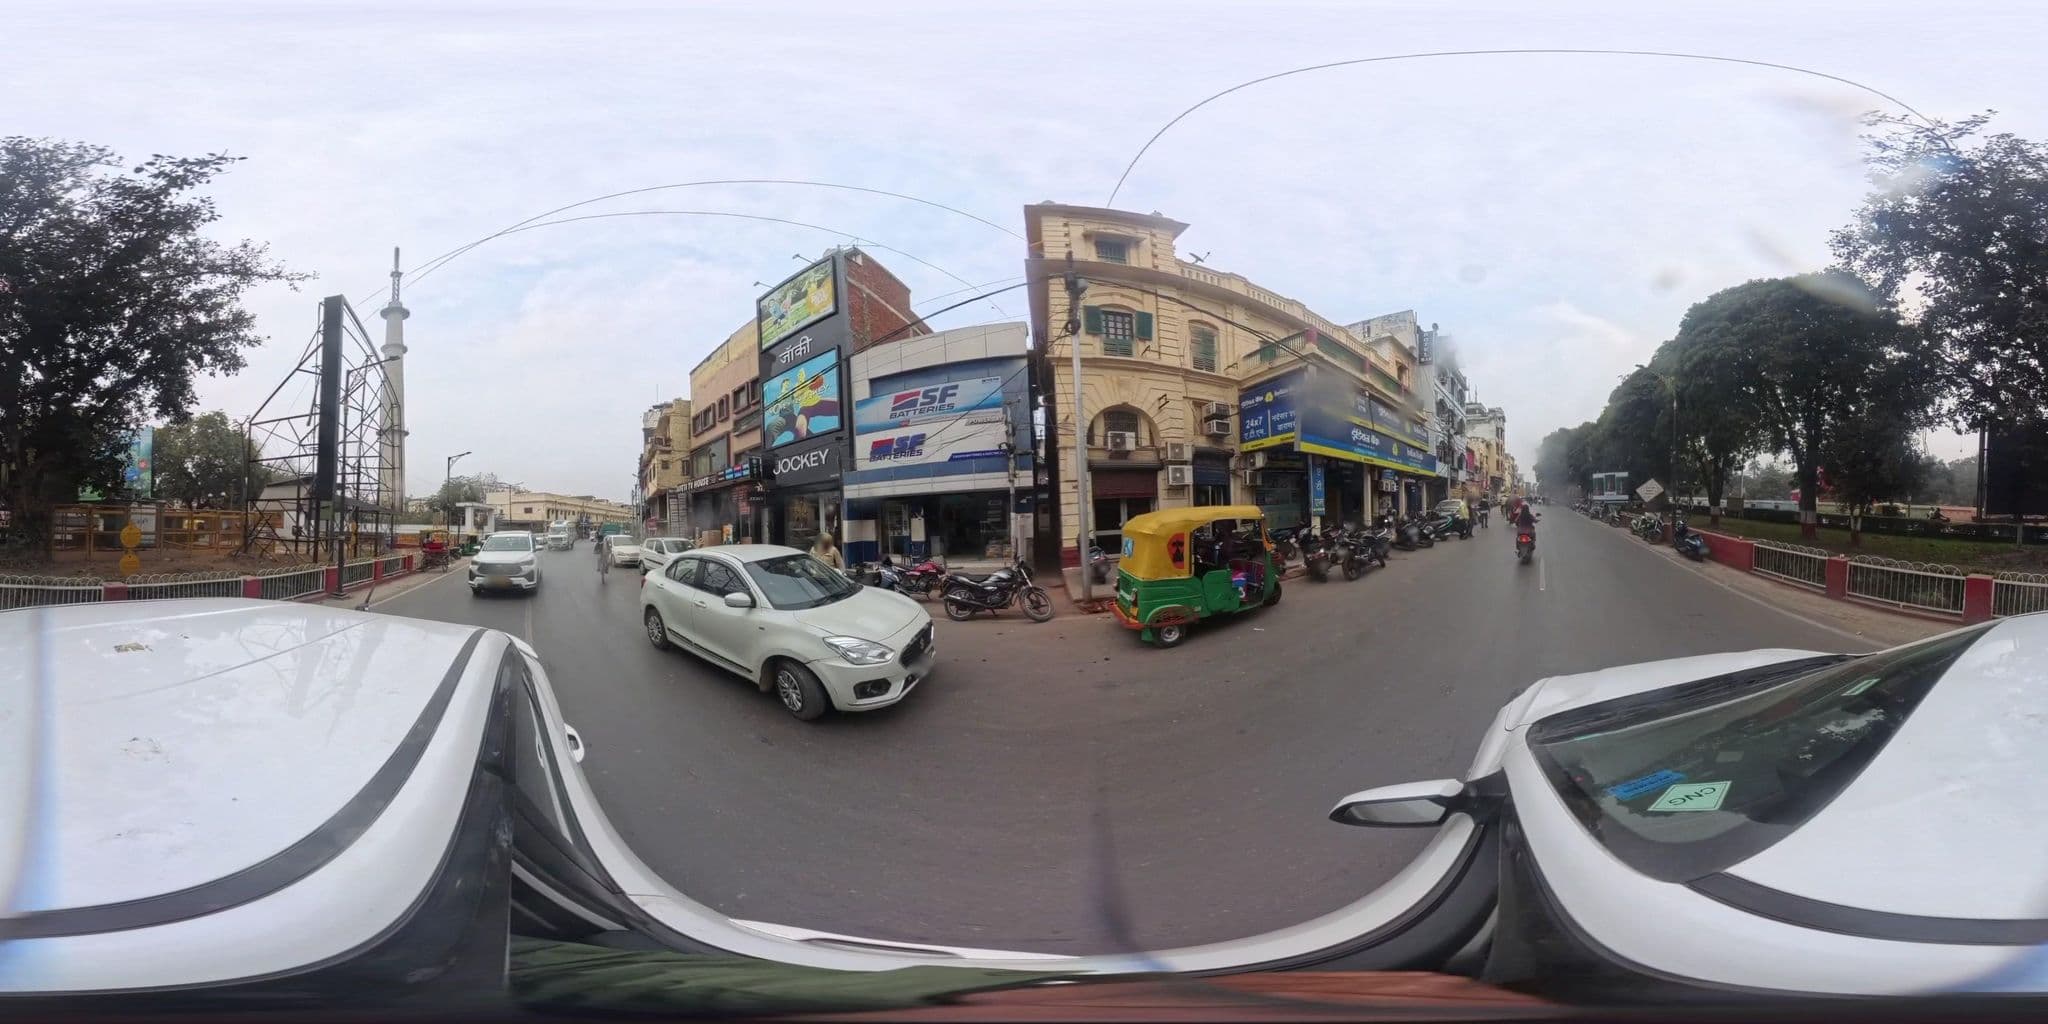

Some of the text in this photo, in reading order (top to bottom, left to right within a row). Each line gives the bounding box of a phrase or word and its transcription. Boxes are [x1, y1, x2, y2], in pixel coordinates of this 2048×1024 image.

[779, 336, 812, 363] जॉकी
[919, 384, 959, 406] SF
[889, 403, 955, 419] BATTERIES
[894, 433, 926, 449] SF
[773, 449, 829, 475] JOCKEY
[869, 449, 923, 462] BATTERIES
[1668, 787, 1706, 805] CNG
